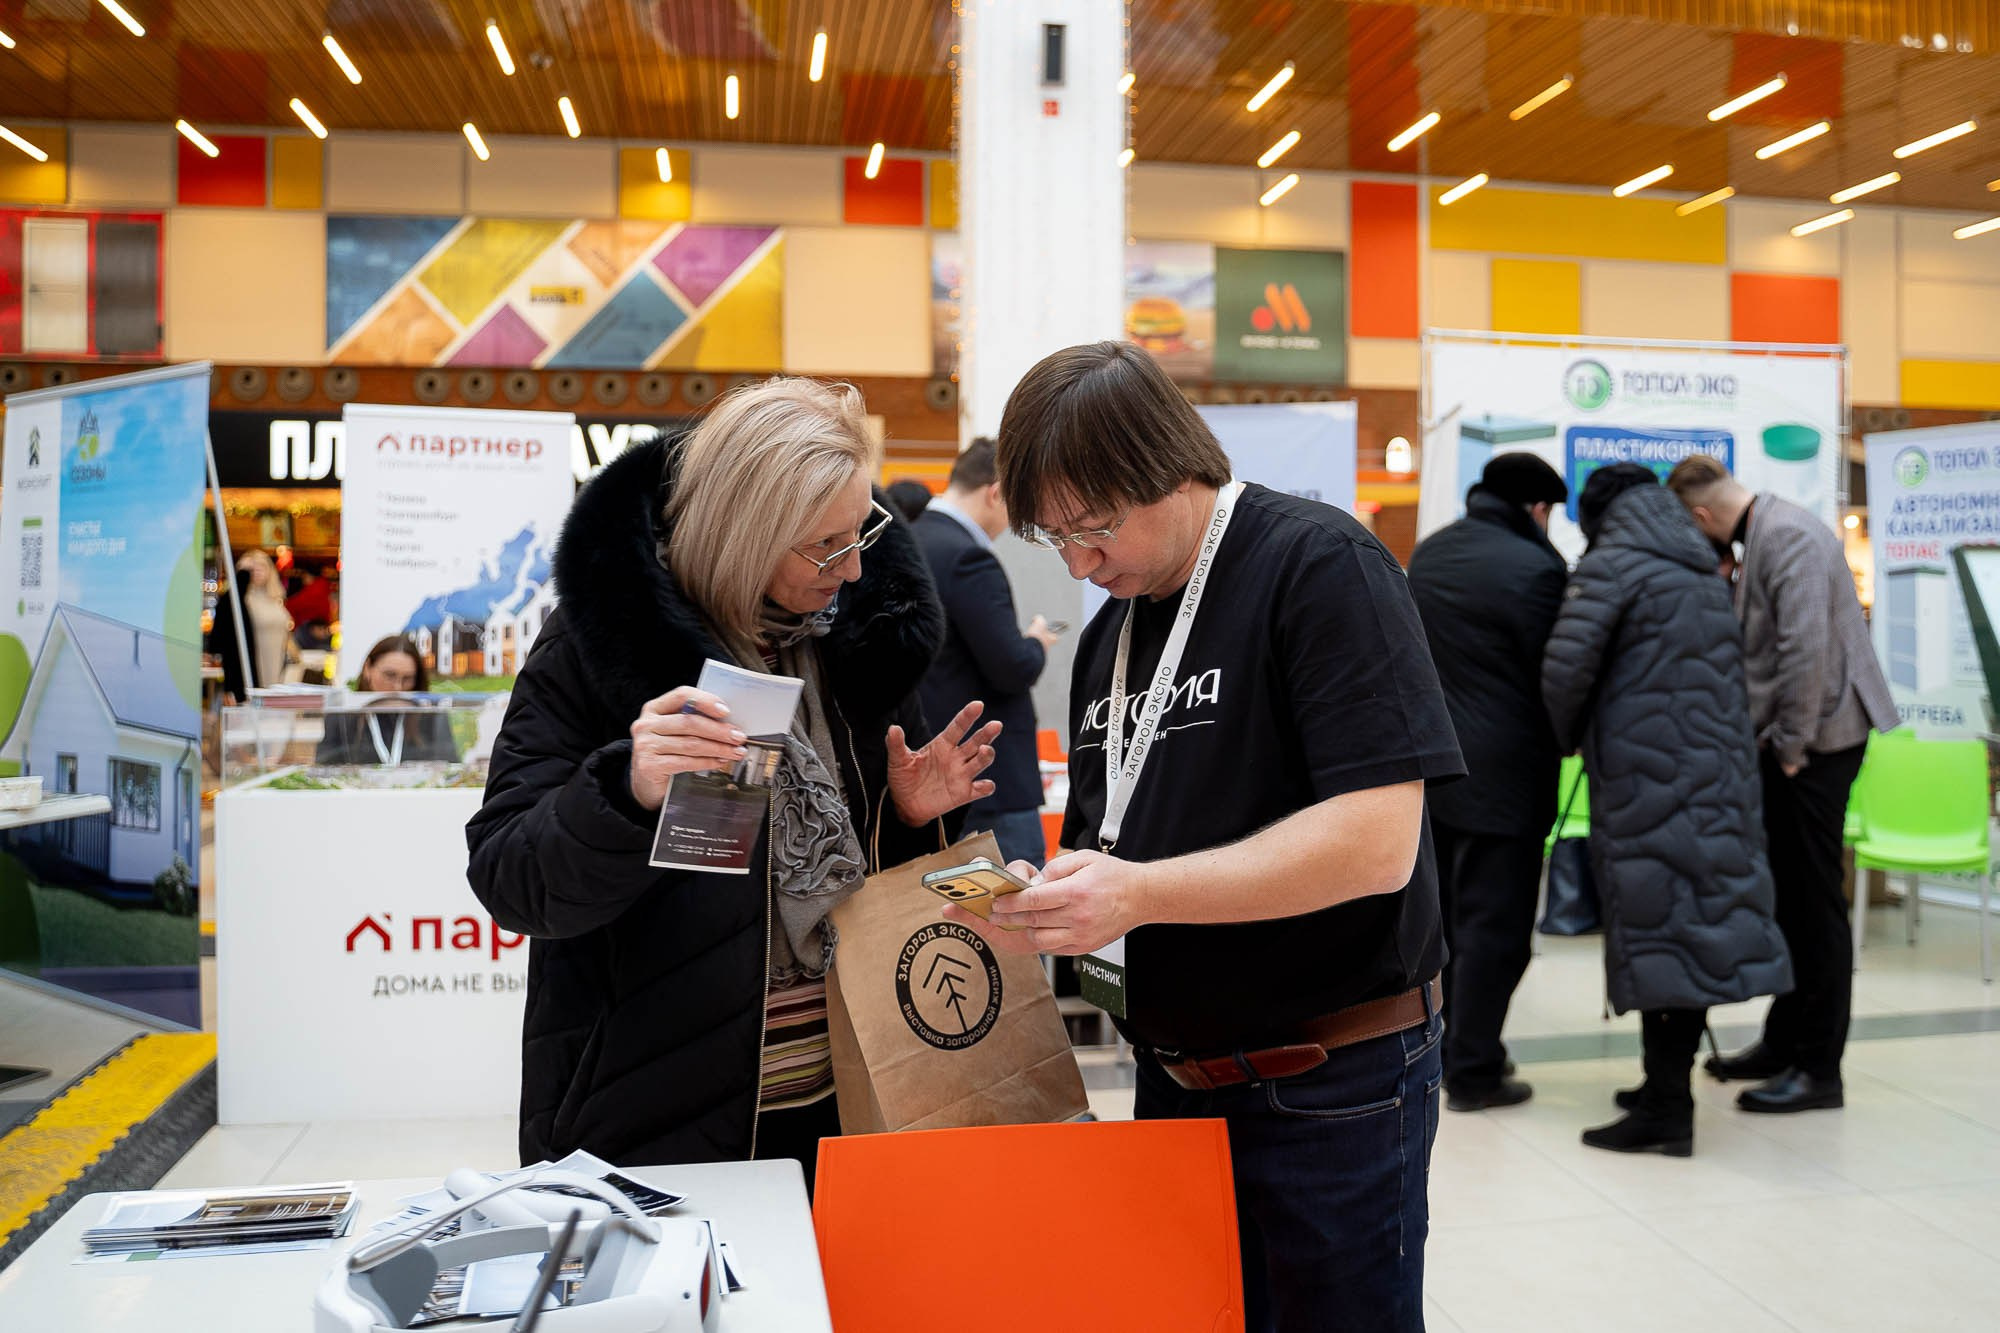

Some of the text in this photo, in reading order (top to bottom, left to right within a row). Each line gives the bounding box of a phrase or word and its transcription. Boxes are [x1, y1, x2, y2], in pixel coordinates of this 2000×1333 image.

[410, 433, 543, 461] партнер
[1574, 437, 1729, 465] ПЛАСТИКОВЫЙ
[1183, 508, 1227, 619] ЗАГОРОД ЭКСПО
[1110, 675, 1123, 780] ЗАГОРОД ЭКСПО
[1126, 666, 1172, 780] ЗАГОРОД ЭКСПО
[1897, 703, 1965, 725] ОГРЕБА
[412, 915, 525, 962] пар
[897, 925, 984, 982] ЗАГОРОД ЭКСПО
[373, 974, 446, 998] ДОМА
[452, 973, 482, 993] НЕ
[1081, 959, 1121, 987] УЧАСТНИК
[902, 1002, 945, 1045] выставка
[946, 1006, 998, 1047] загородной
